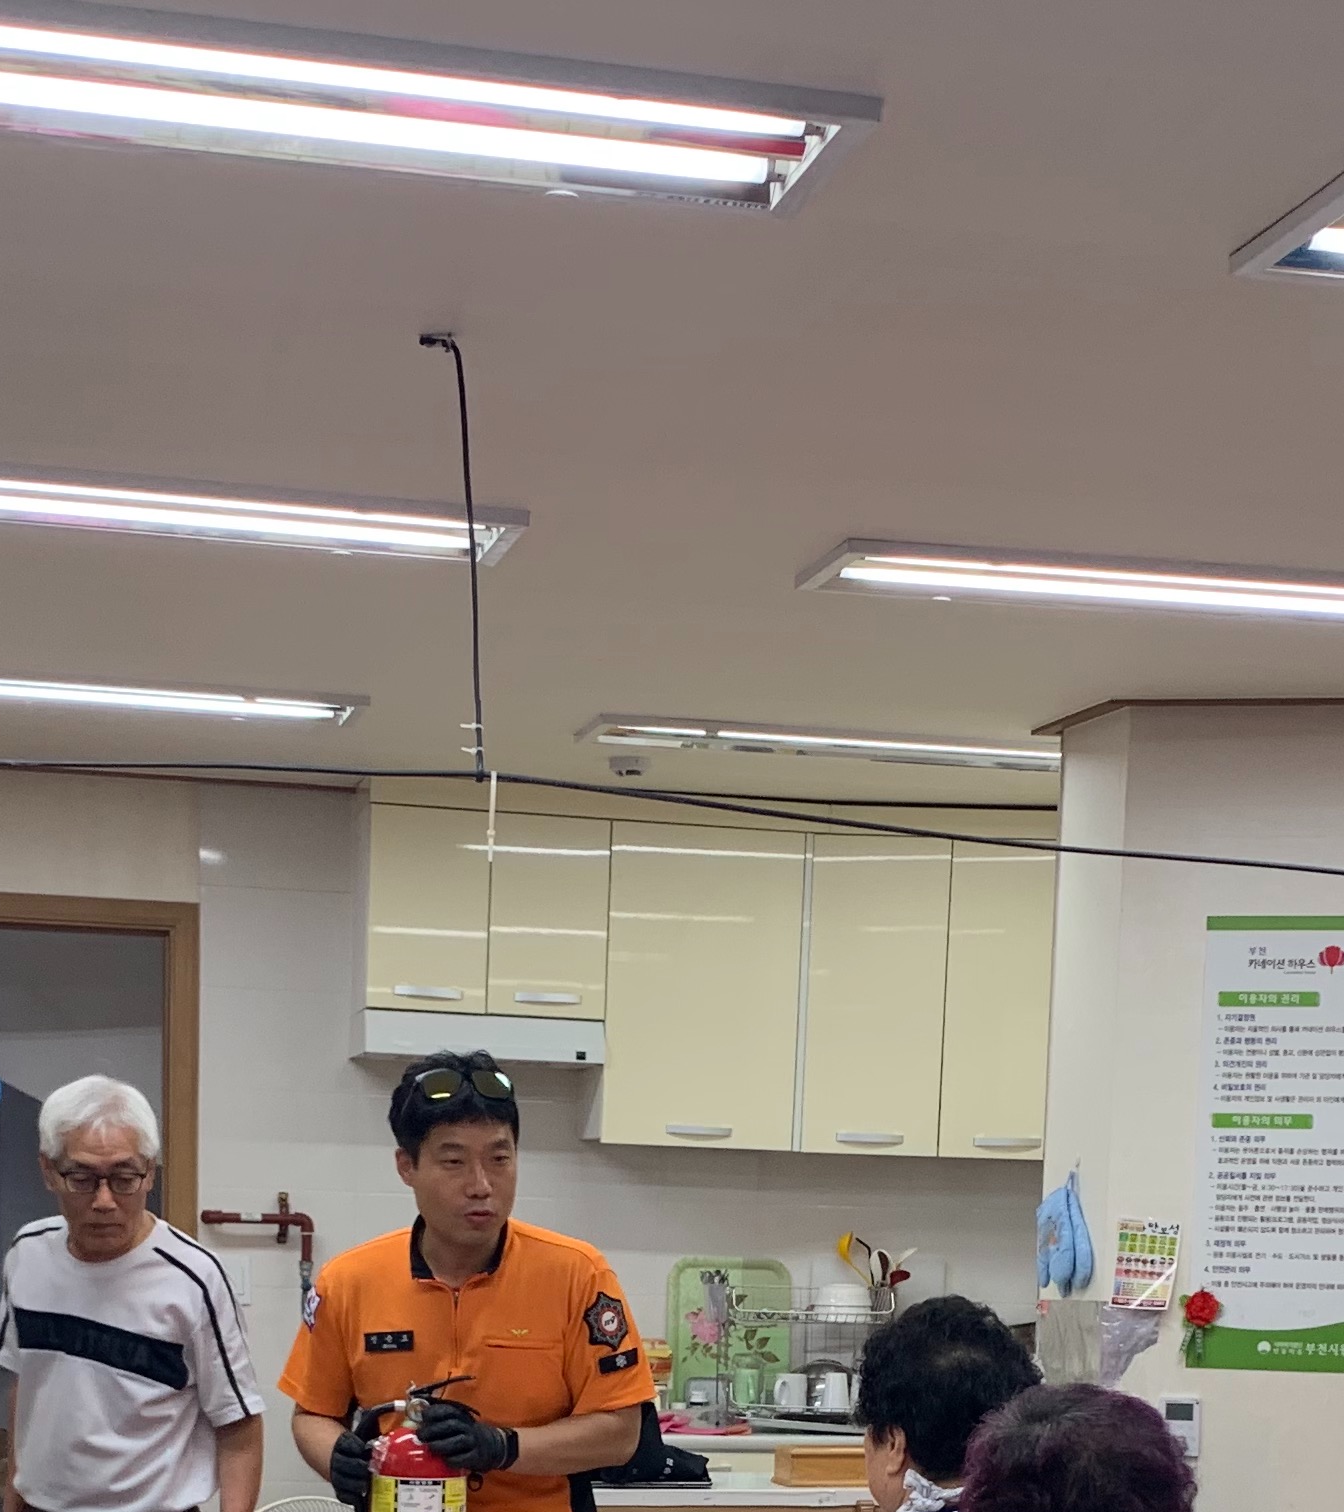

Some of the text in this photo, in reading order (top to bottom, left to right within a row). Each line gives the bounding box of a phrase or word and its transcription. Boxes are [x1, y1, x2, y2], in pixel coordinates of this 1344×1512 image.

[1248, 958, 1316, 970] 카네이션 하우스
[1238, 993, 1277, 1004] 이용자의
[1232, 1115, 1293, 1126] 이용자의 의무
